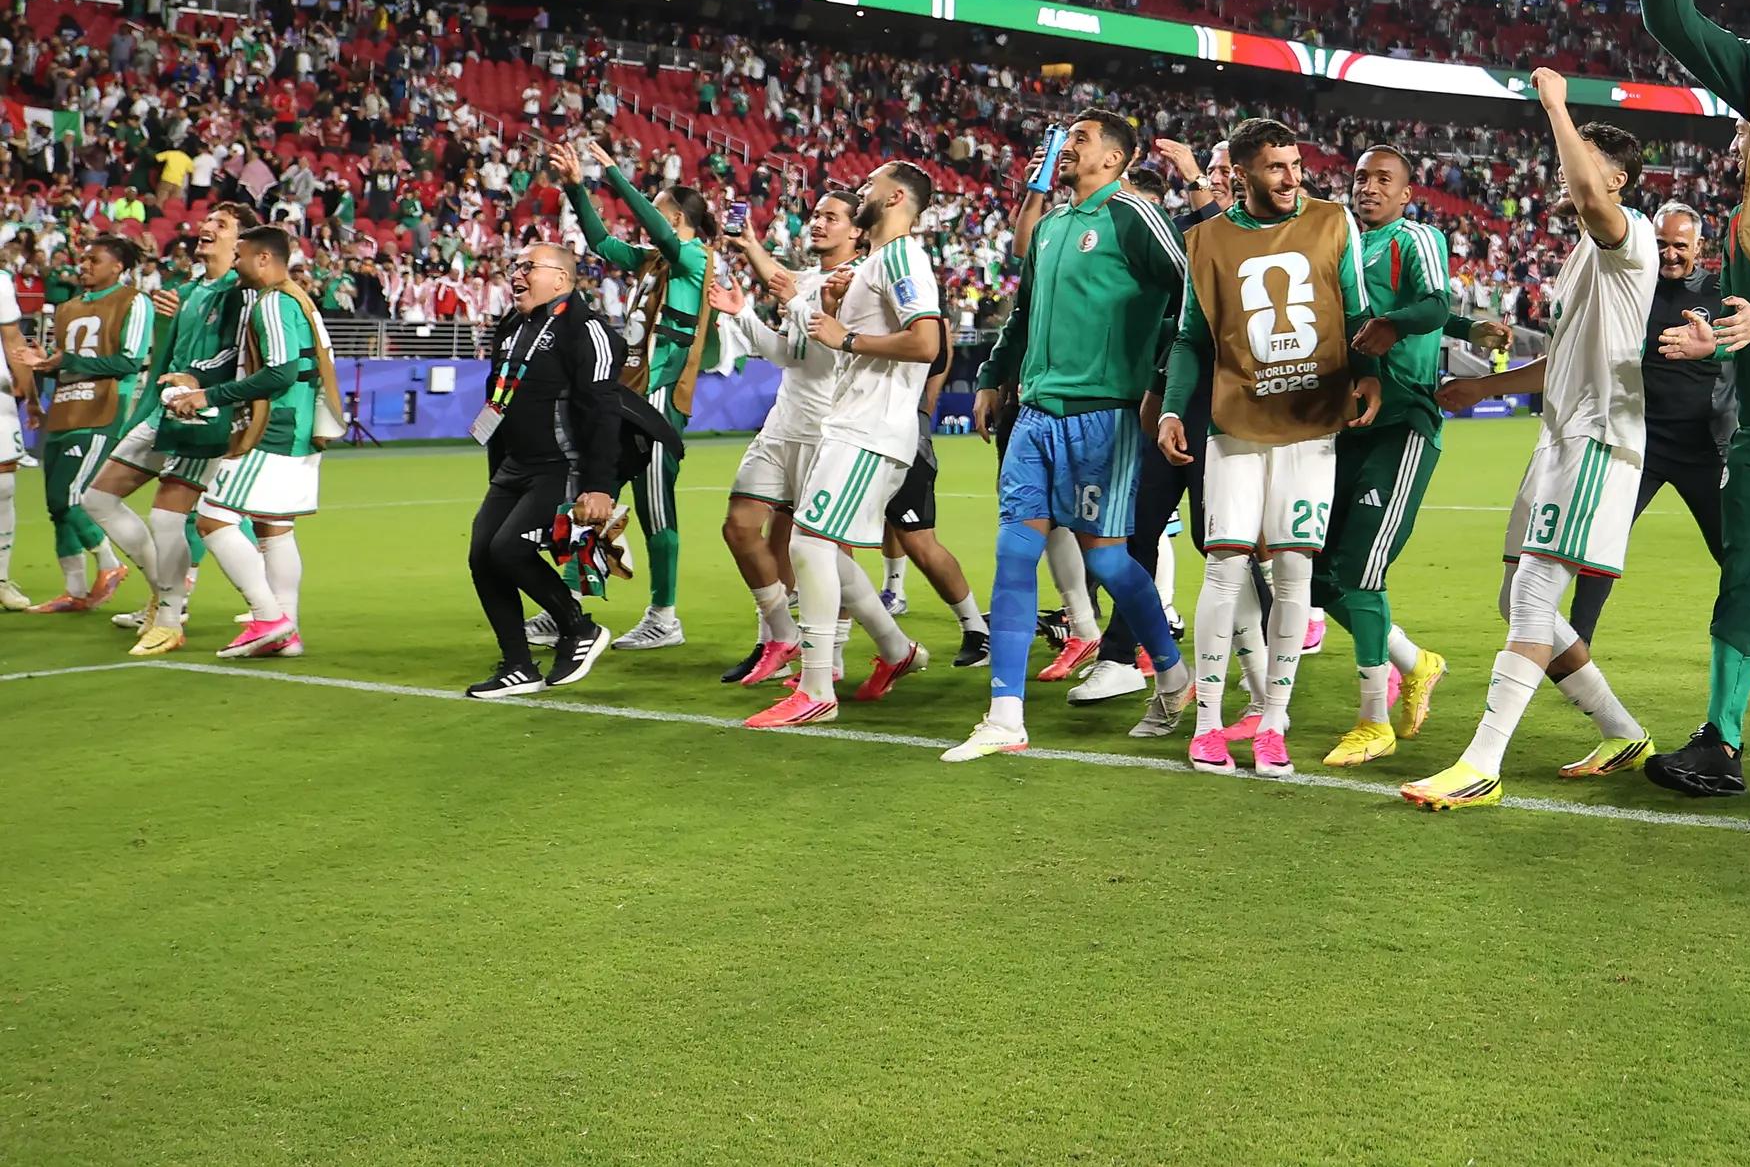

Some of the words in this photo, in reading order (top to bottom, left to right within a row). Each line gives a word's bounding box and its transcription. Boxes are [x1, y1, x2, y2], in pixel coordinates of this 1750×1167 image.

[1270, 338, 1300, 351] FIFA
[1254, 365, 1295, 380] WORLD
[1296, 362, 1318, 373] CUP
[1255, 374, 1320, 396] 2026
[1527, 502, 1560, 544] 13
[1233, 627, 1248, 637] AF
[1202, 654, 1223, 662] FAF
[1276, 655, 1297, 663] FAF
